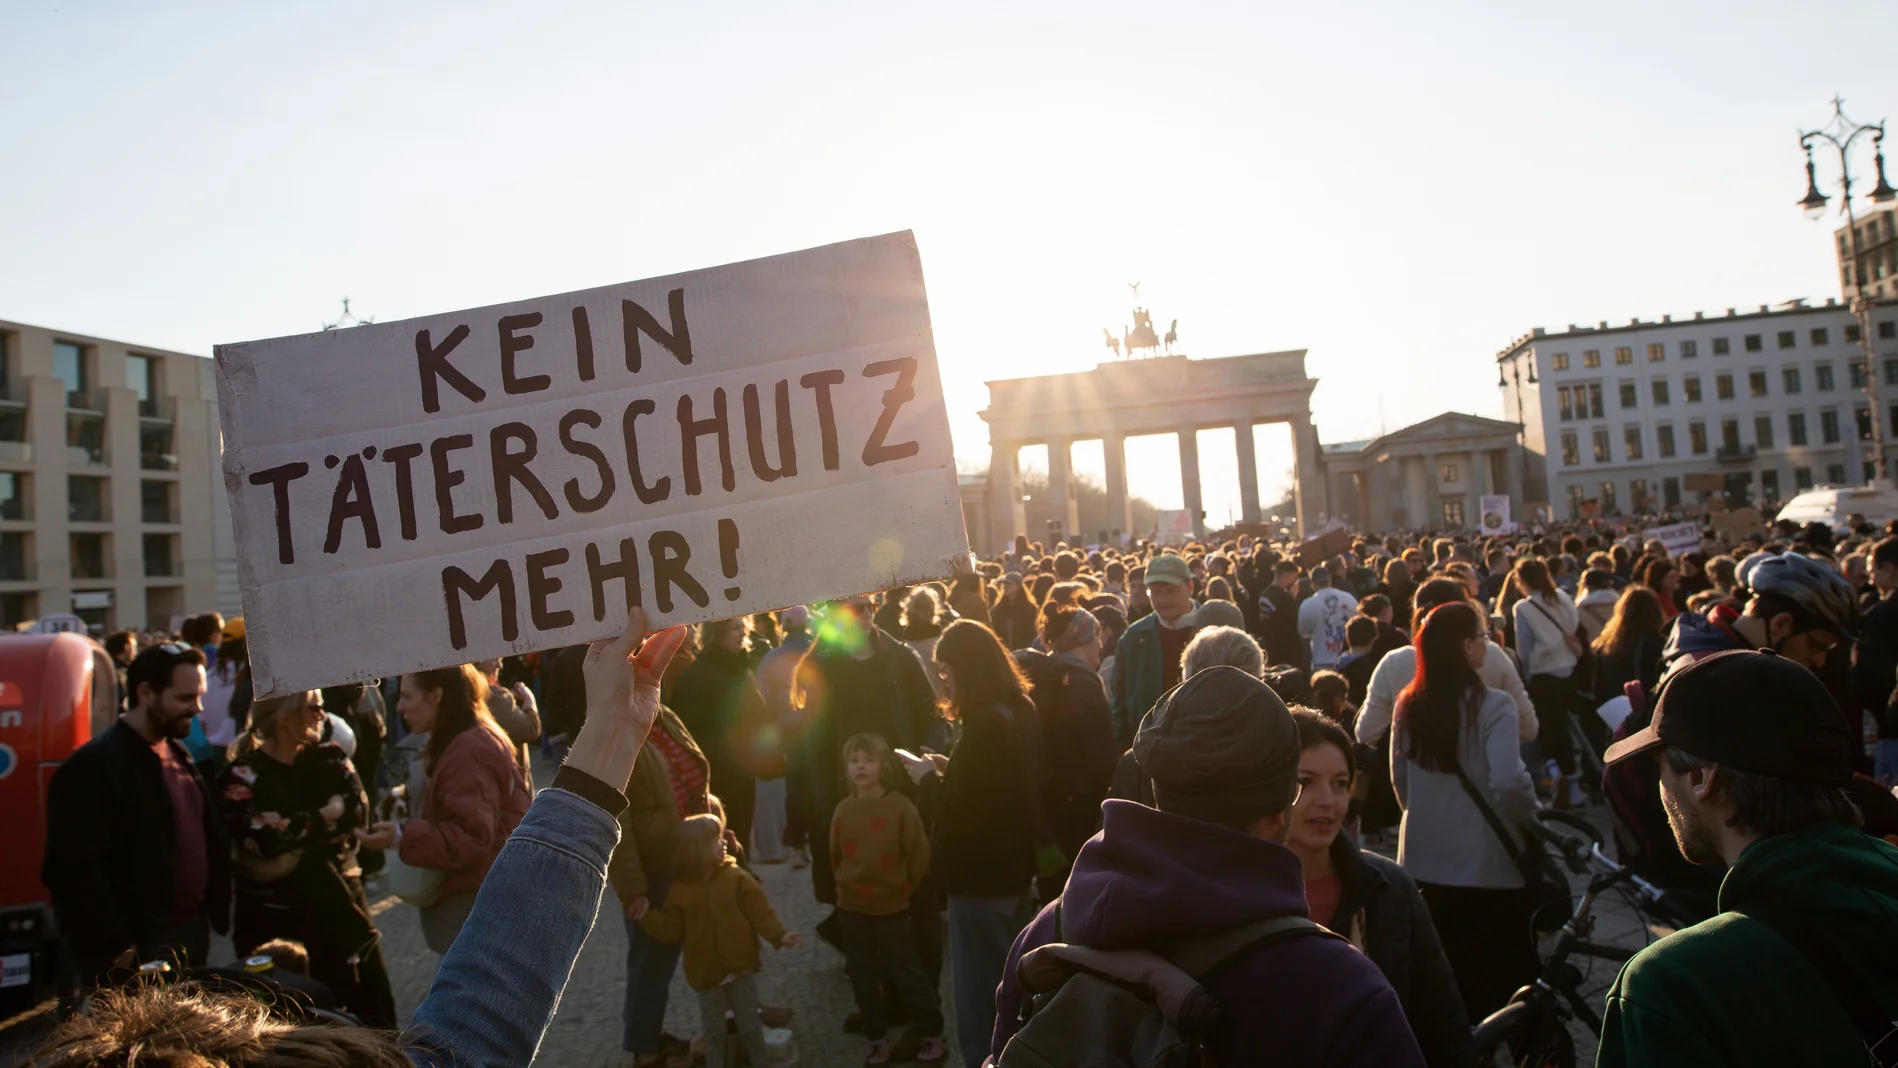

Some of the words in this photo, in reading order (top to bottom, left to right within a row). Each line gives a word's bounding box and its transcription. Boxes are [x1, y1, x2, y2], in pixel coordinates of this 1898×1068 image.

[414, 287, 694, 414] KEIN
[250, 356, 921, 566] TÄTERSCHUTZ
[442, 519, 741, 650] MEHR!
